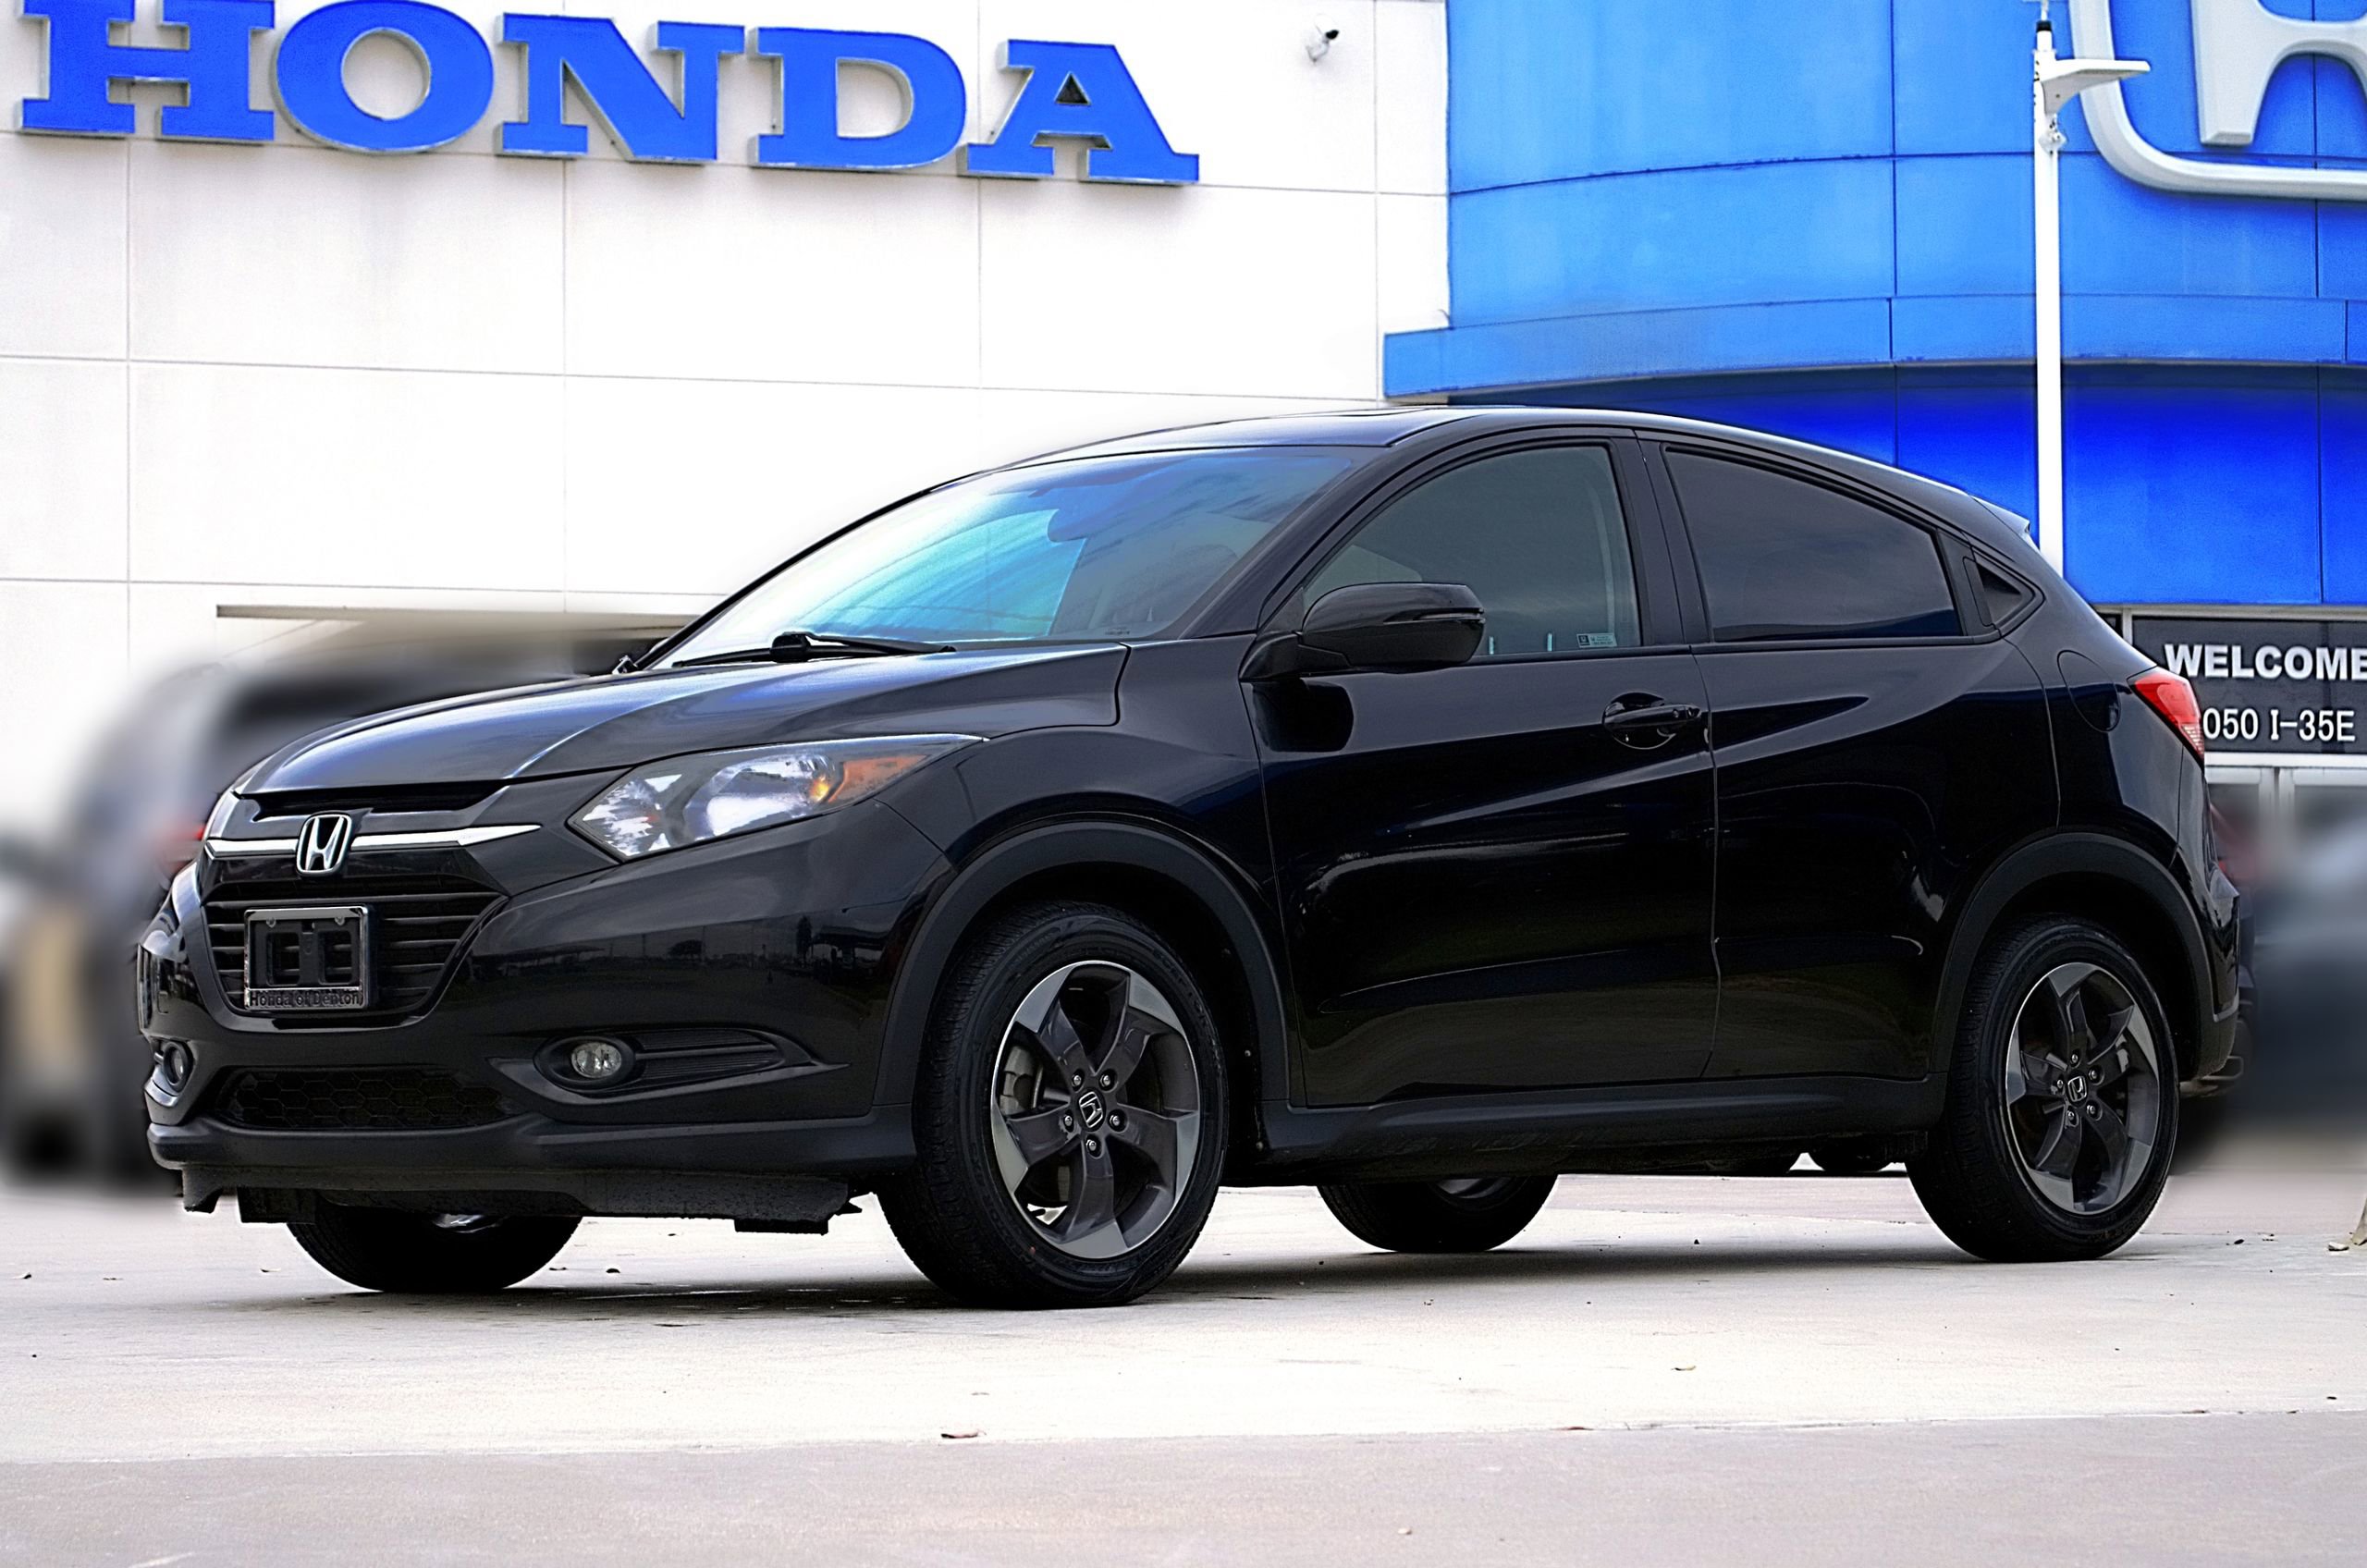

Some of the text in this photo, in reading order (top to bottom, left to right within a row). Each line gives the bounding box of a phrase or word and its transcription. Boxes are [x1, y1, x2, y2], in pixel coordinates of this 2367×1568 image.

[16, 0, 1201, 184] HONDA
[2164, 643, 2367, 681] WELCOME
[2202, 707, 2356, 742] 050 I-35E
[251, 990, 291, 1008] Honda
[313, 989, 360, 1006] Denton
